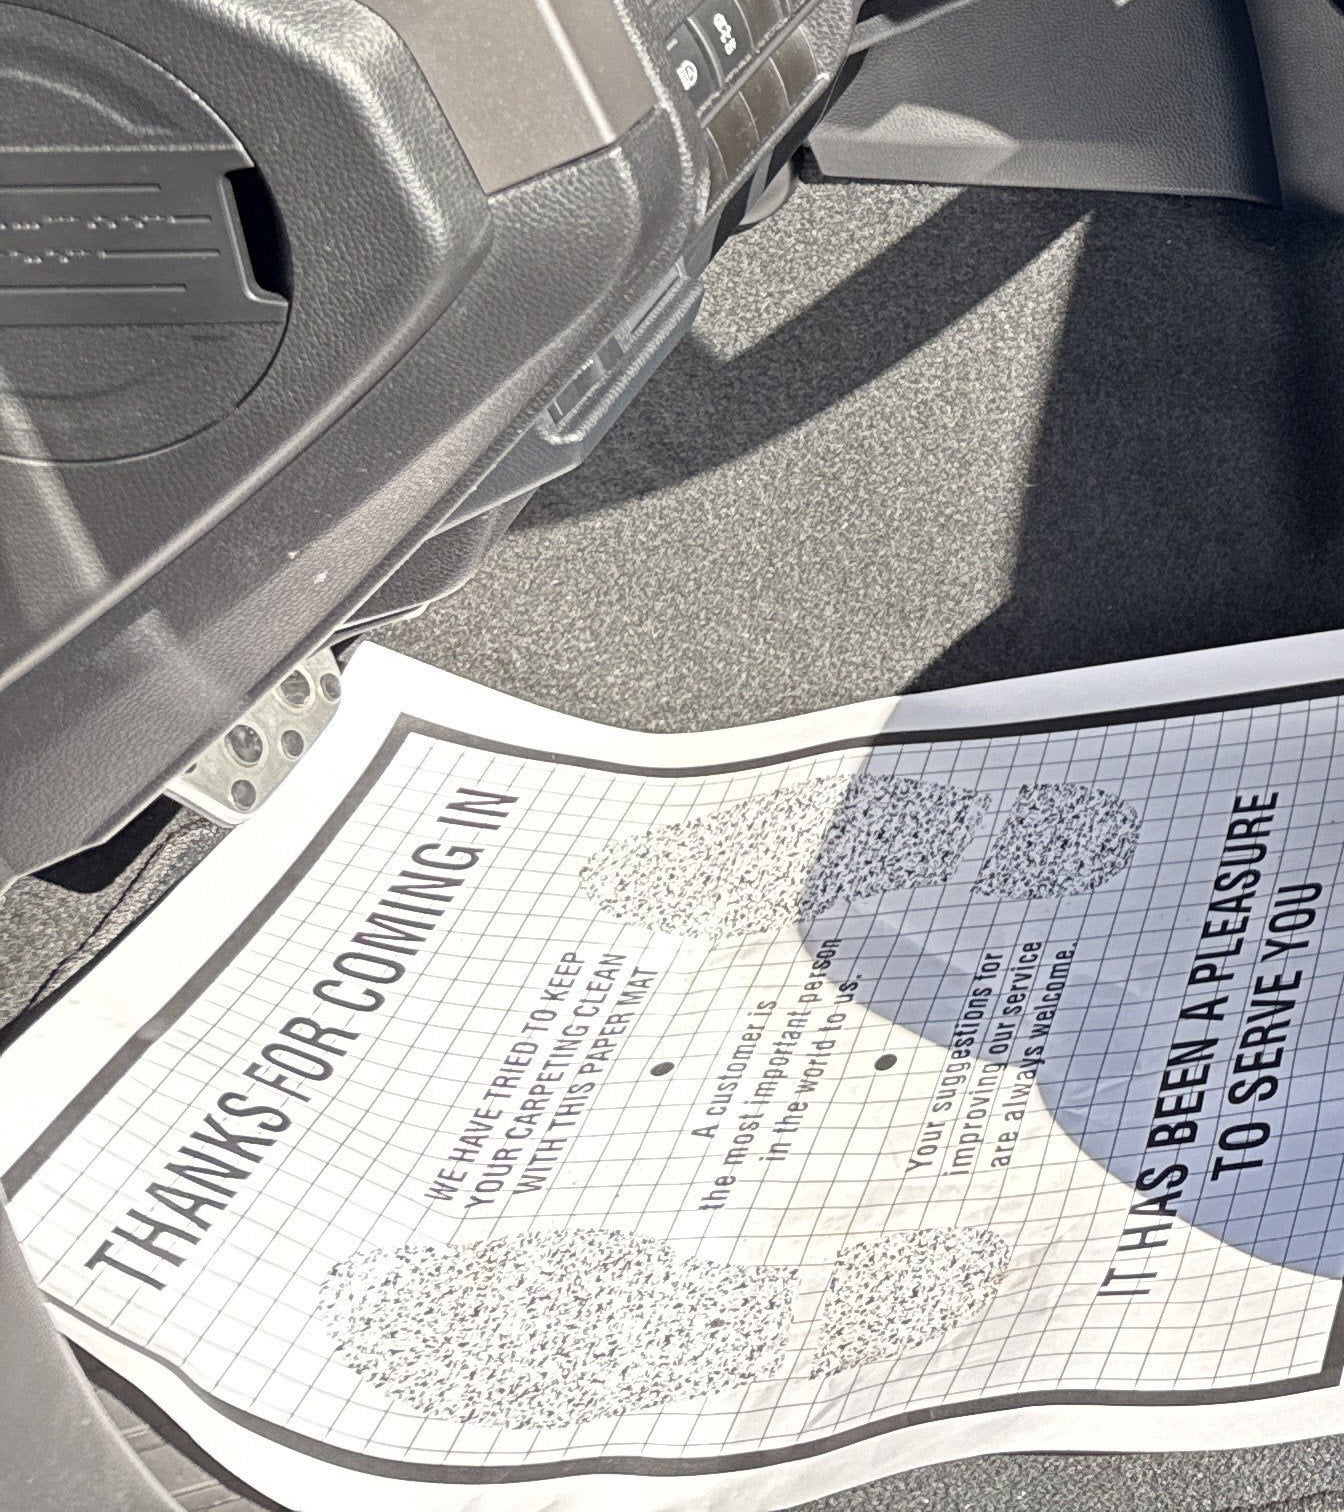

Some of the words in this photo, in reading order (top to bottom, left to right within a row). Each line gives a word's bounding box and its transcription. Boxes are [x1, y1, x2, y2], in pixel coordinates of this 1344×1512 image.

[1188, 791, 1278, 985] PLEASURE
[1261, 882, 1323, 963] YOU
[799, 939, 842, 1003] person
[834, 974, 862, 1004] us.
[1002, 941, 1042, 1015] service
[1030, 941, 1078, 1039] welcome.
[1180, 996, 1228, 1021] A
[84, 1091, 292, 1291] THANKS
[243, 1017, 360, 1103] FOR
[313, 842, 485, 1013] COMING
[437, 787, 520, 830] IN
[743, 1011, 811, 1104] important
[818, 1013, 846, 1032] to
[989, 1022, 1016, 1054] our
[1228, 970, 1303, 1102] SERVE
[424, 1168, 468, 1200] WE
[448, 1108, 503, 1162] HAVE
[484, 1042, 538, 1100] TRIED
[521, 1009, 557, 1033] TO
[540, 952, 585, 1001] KEEP
[464, 1148, 523, 1209] YOUR
[505, 1025, 589, 1139] CARPETING
[573, 953, 627, 1017] CLEAN
[512, 1138, 567, 1194] WITH
[550, 1082, 595, 1130] THIS
[578, 1012, 635, 1074] PAPER
[616, 966, 658, 1005] MAT
[691, 1124, 719, 1138] A
[706, 1022, 765, 1117] customer
[747, 1000, 777, 1015] is
[794, 1040, 836, 1094] world
[905, 1121, 945, 1173] Your
[932, 988, 992, 1112] suggestions
[974, 953, 1003, 981] for
[1002, 1046, 1046, 1121] always
[1148, 1037, 1219, 1149] BEEN
[723, 1113, 764, 1165] most
[759, 1143, 791, 1161] in
[773, 1101, 808, 1134] the
[942, 1062, 1007, 1176] improving
[991, 1131, 1019, 1168] are
[1211, 1121, 1271, 1182] TO
[698, 1175, 736, 1210] the
[1117, 1163, 1189, 1251] HAS
[1096, 1268, 1159, 1297] IT
